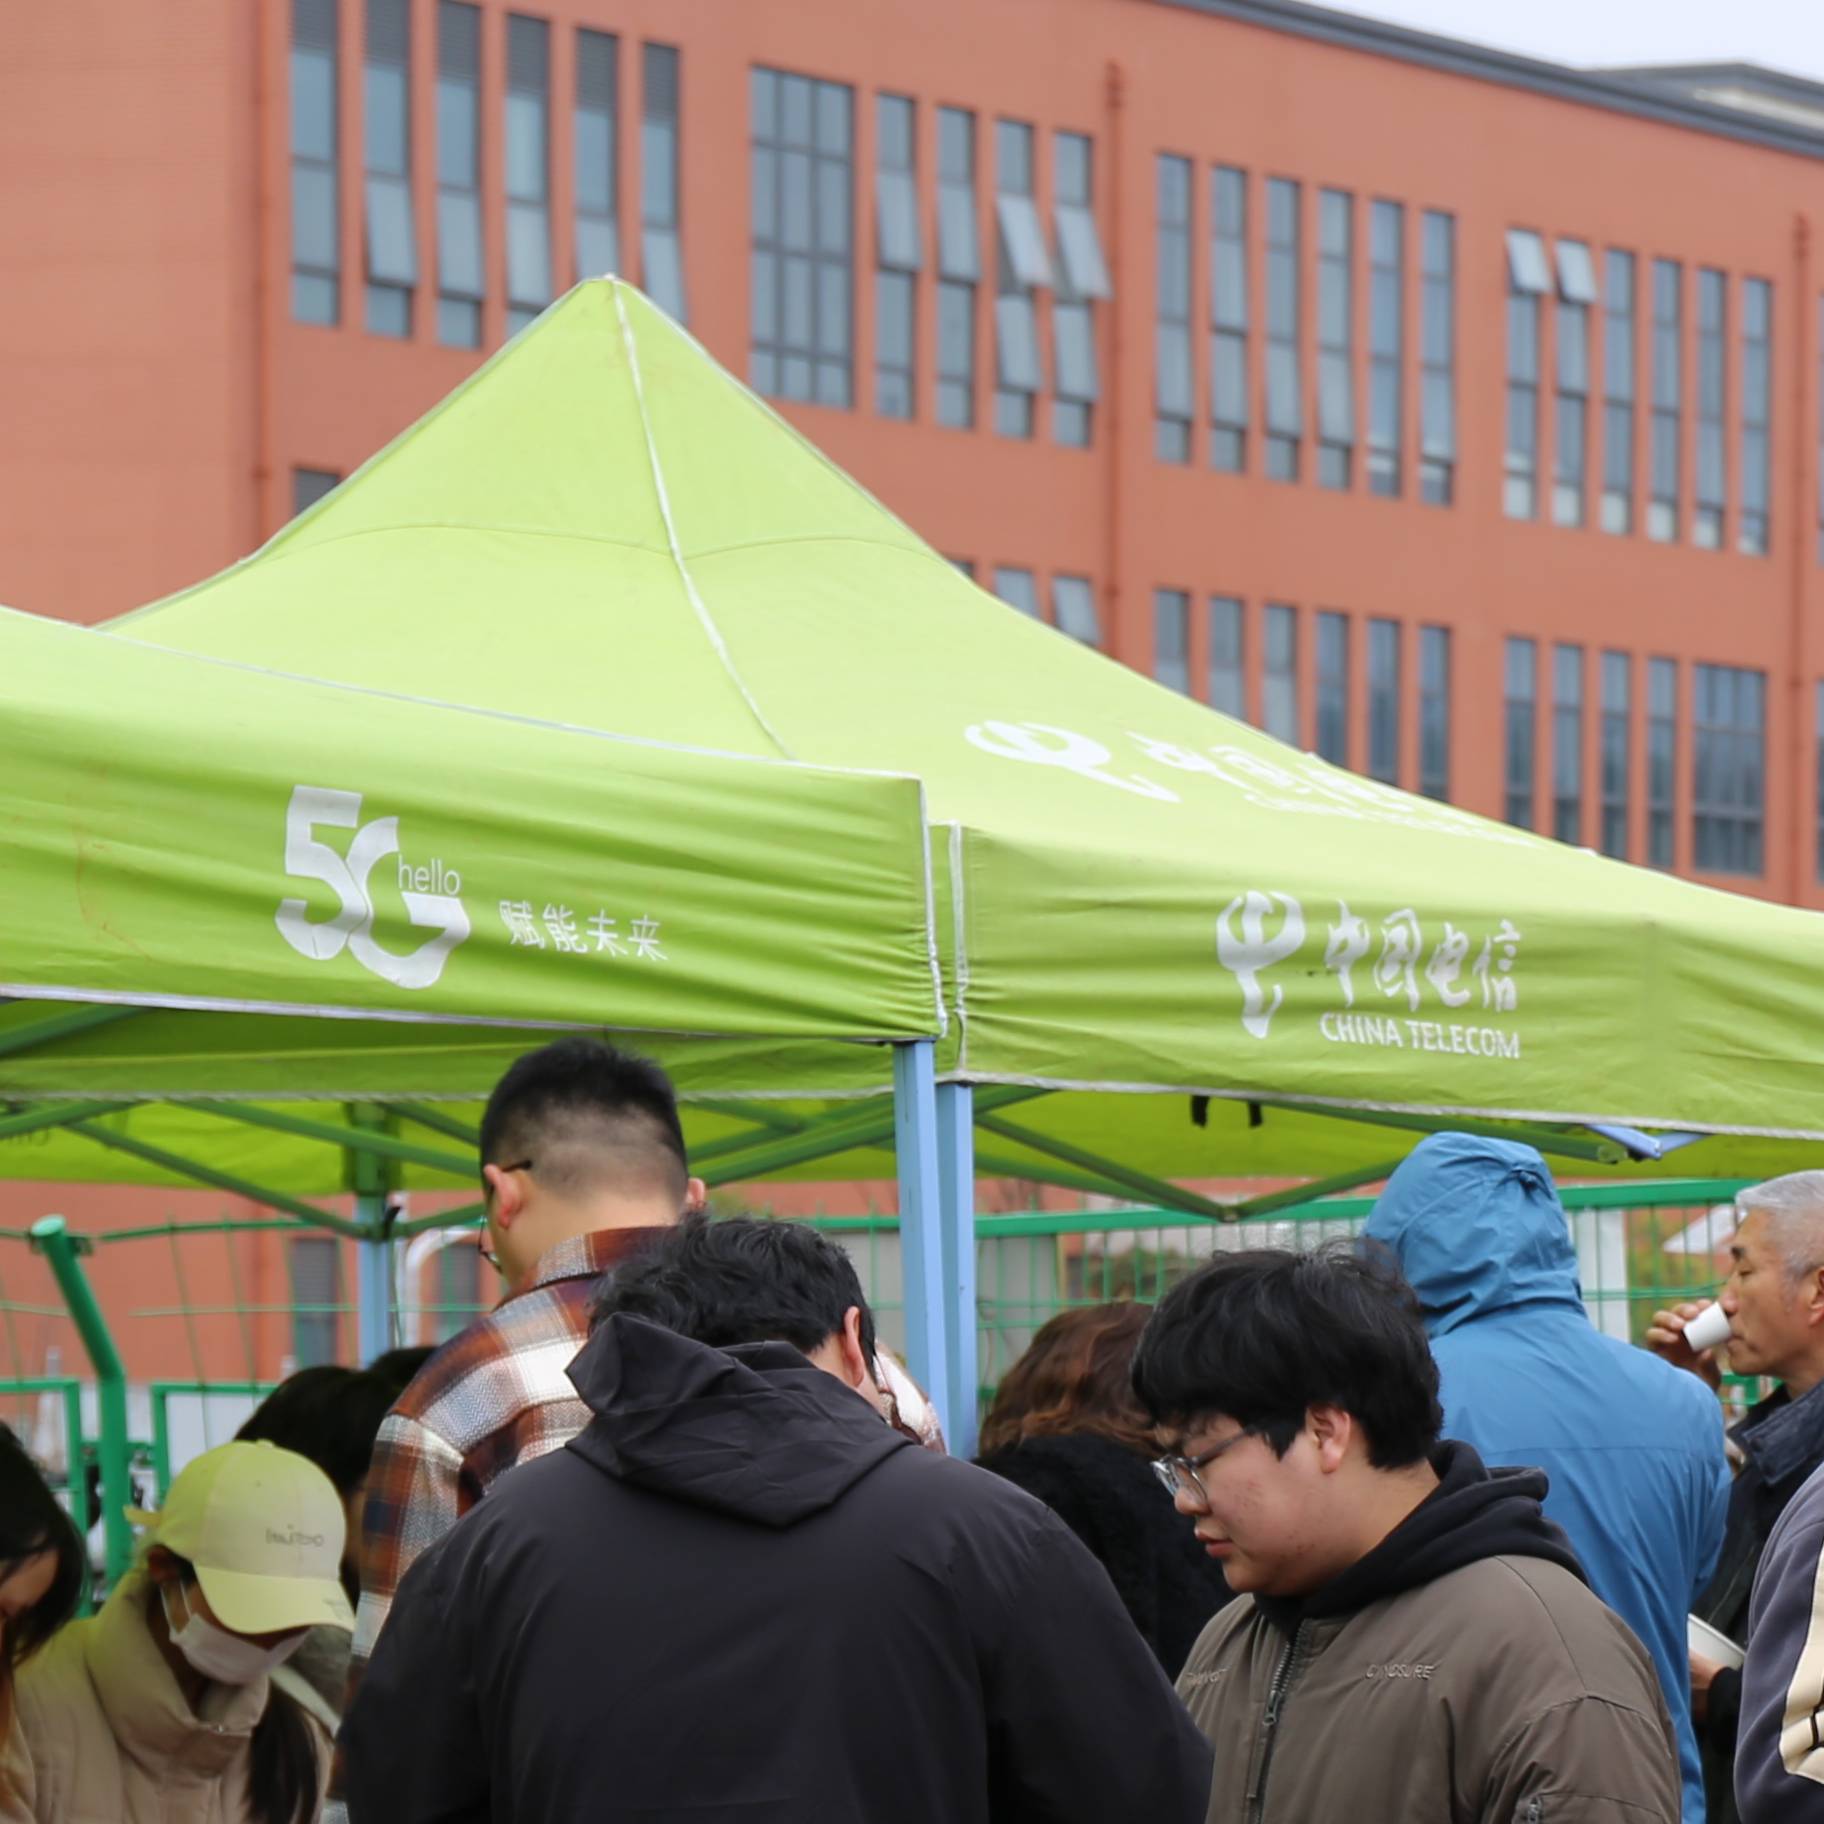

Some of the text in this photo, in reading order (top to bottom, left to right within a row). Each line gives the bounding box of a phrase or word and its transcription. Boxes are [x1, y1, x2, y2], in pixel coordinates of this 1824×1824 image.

[274, 784, 471, 989] 5G
[397, 854, 461, 896] hello
[499, 899, 669, 961] 赋能未来
[1324, 898, 1521, 1012] 中国电信
[1319, 1011, 1521, 1059] CHINA TELECOM
